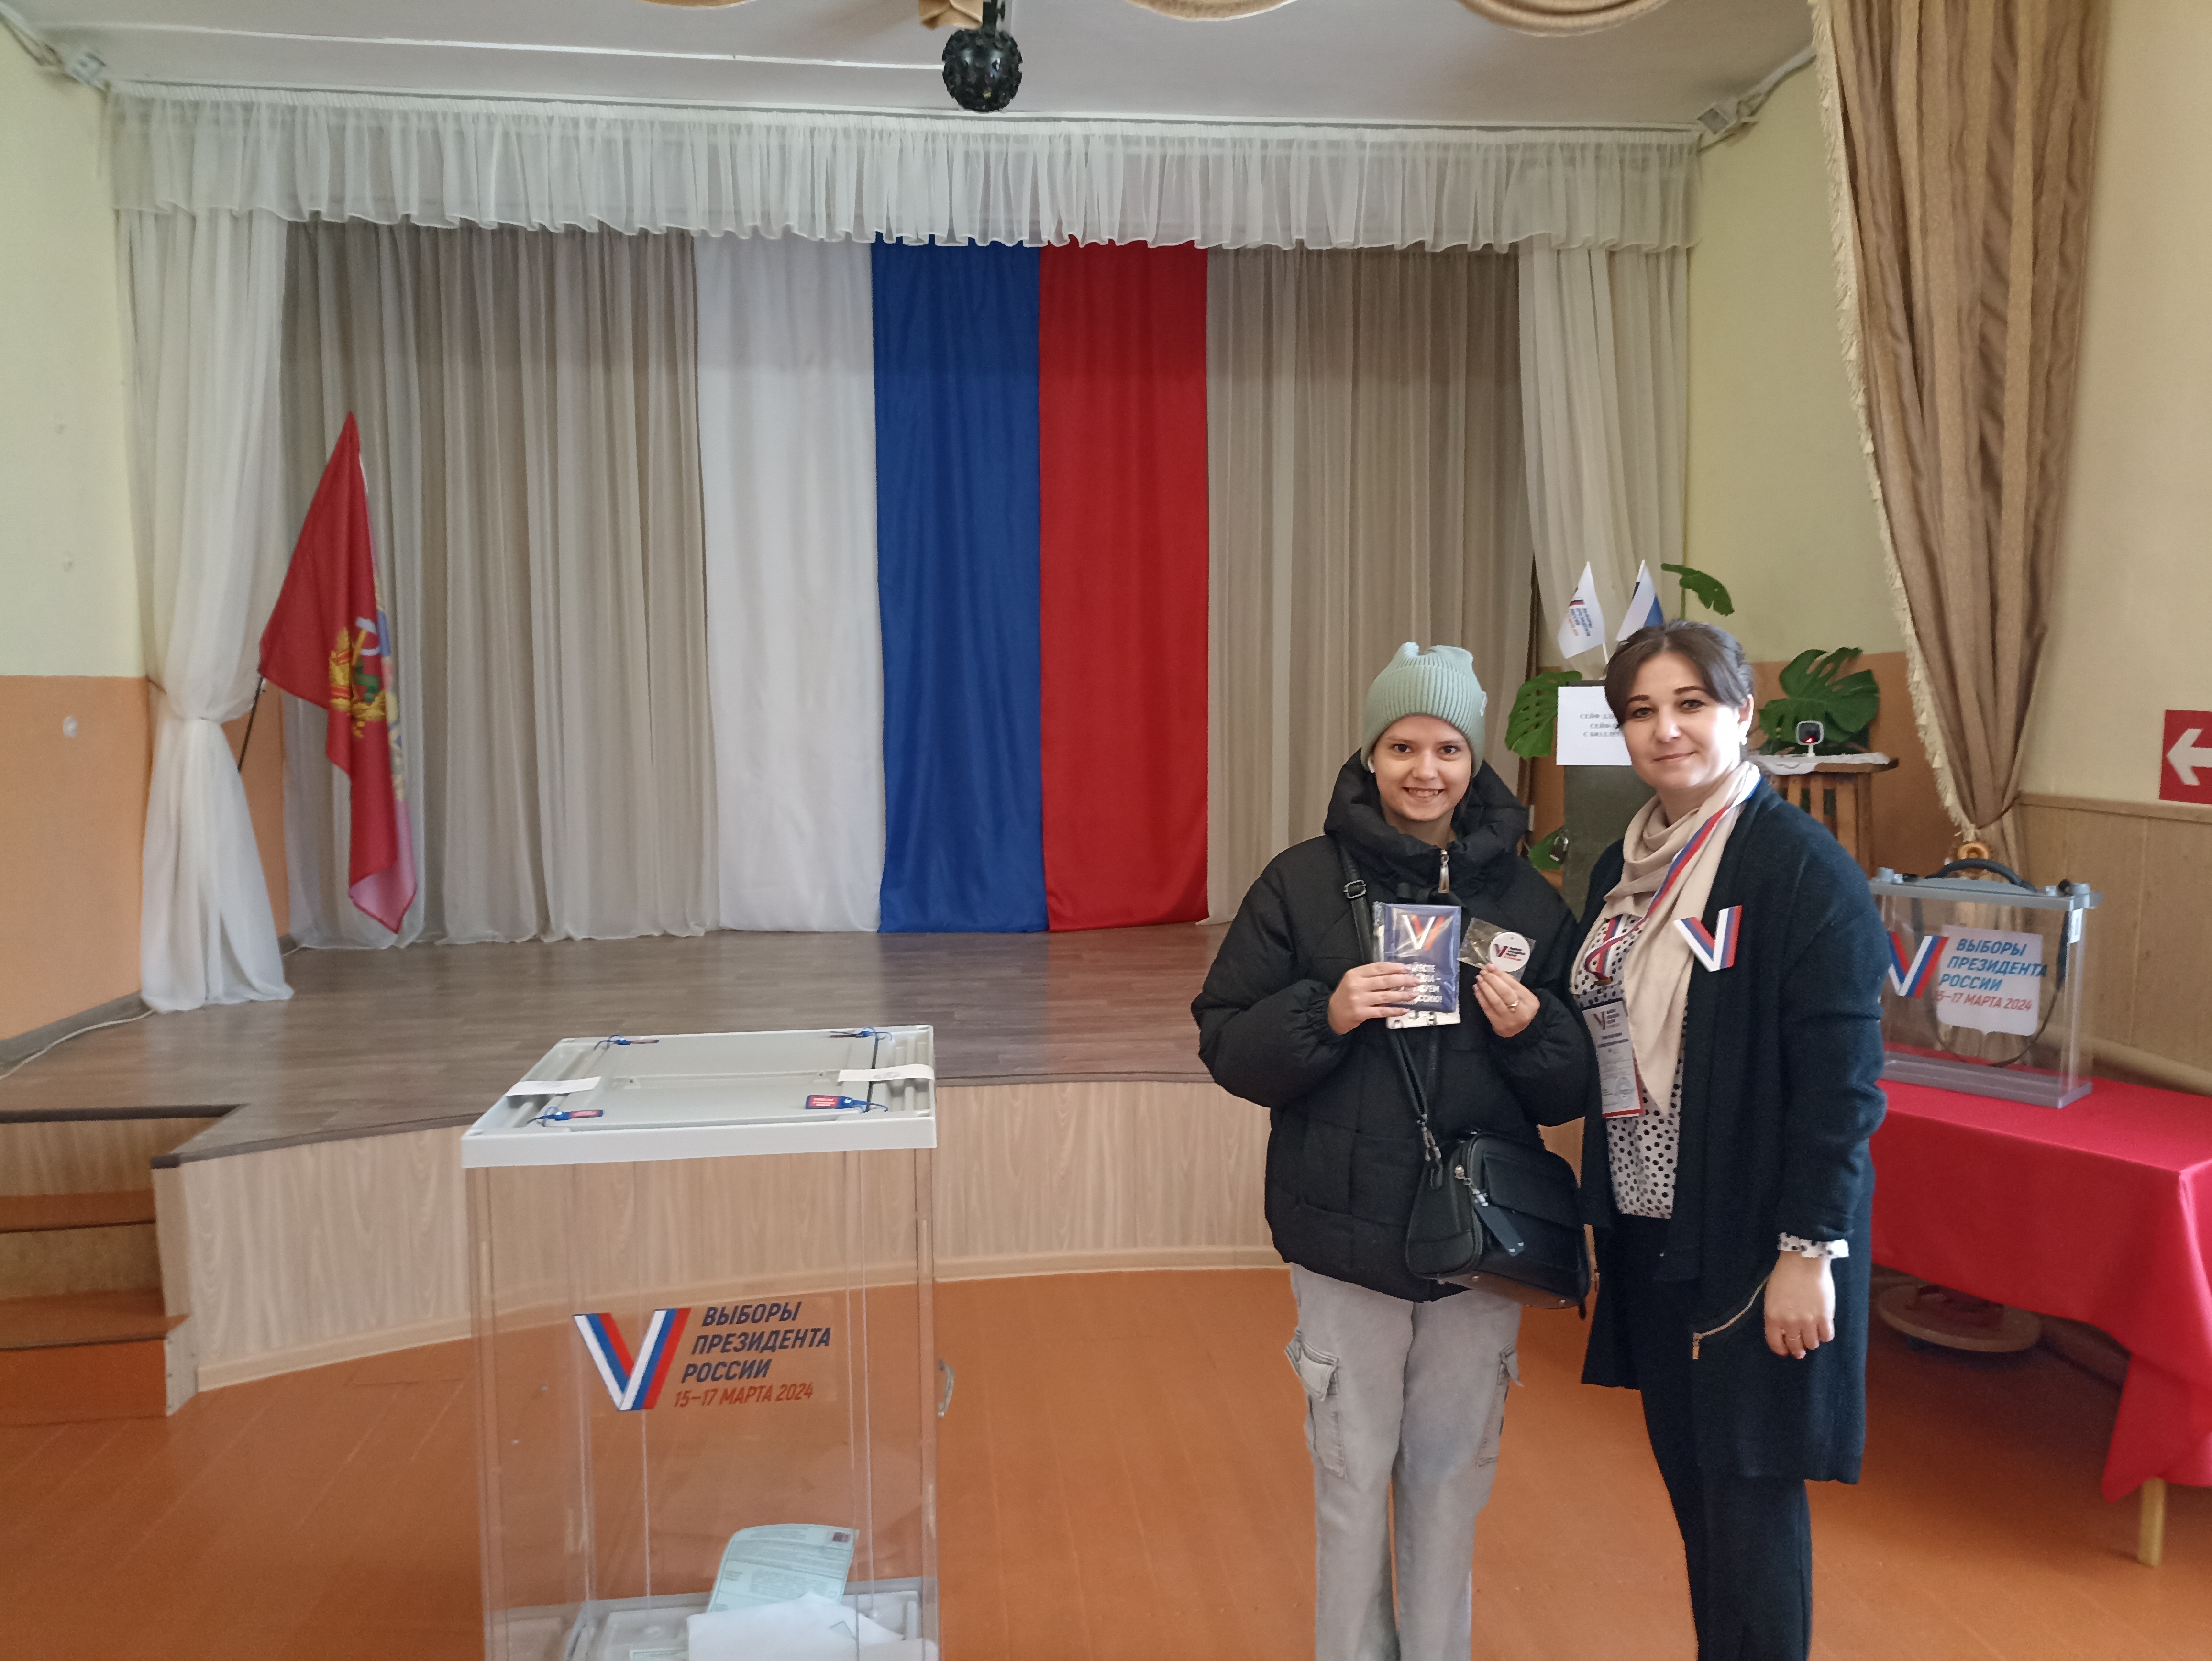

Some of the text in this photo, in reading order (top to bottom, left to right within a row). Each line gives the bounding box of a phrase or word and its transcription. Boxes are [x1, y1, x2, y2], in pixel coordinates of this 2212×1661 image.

[1956, 938, 2027, 956] ВЫБОРЫ
[1947, 956, 2048, 977] ПРЕЗИДЕНТА
[1939, 974, 2003, 991] РОССИИ
[1964, 994, 2002, 1008] МАРТА
[2003, 998, 2032, 1011] 2024
[702, 1301, 802, 1327] ВЫБОРЫ
[692, 1327, 831, 1354] ПРЕЗИДЕНТА
[682, 1359, 772, 1383] РОССИИ
[720, 1385, 772, 1405] МАРТА
[776, 1382, 814, 1402] 2024
